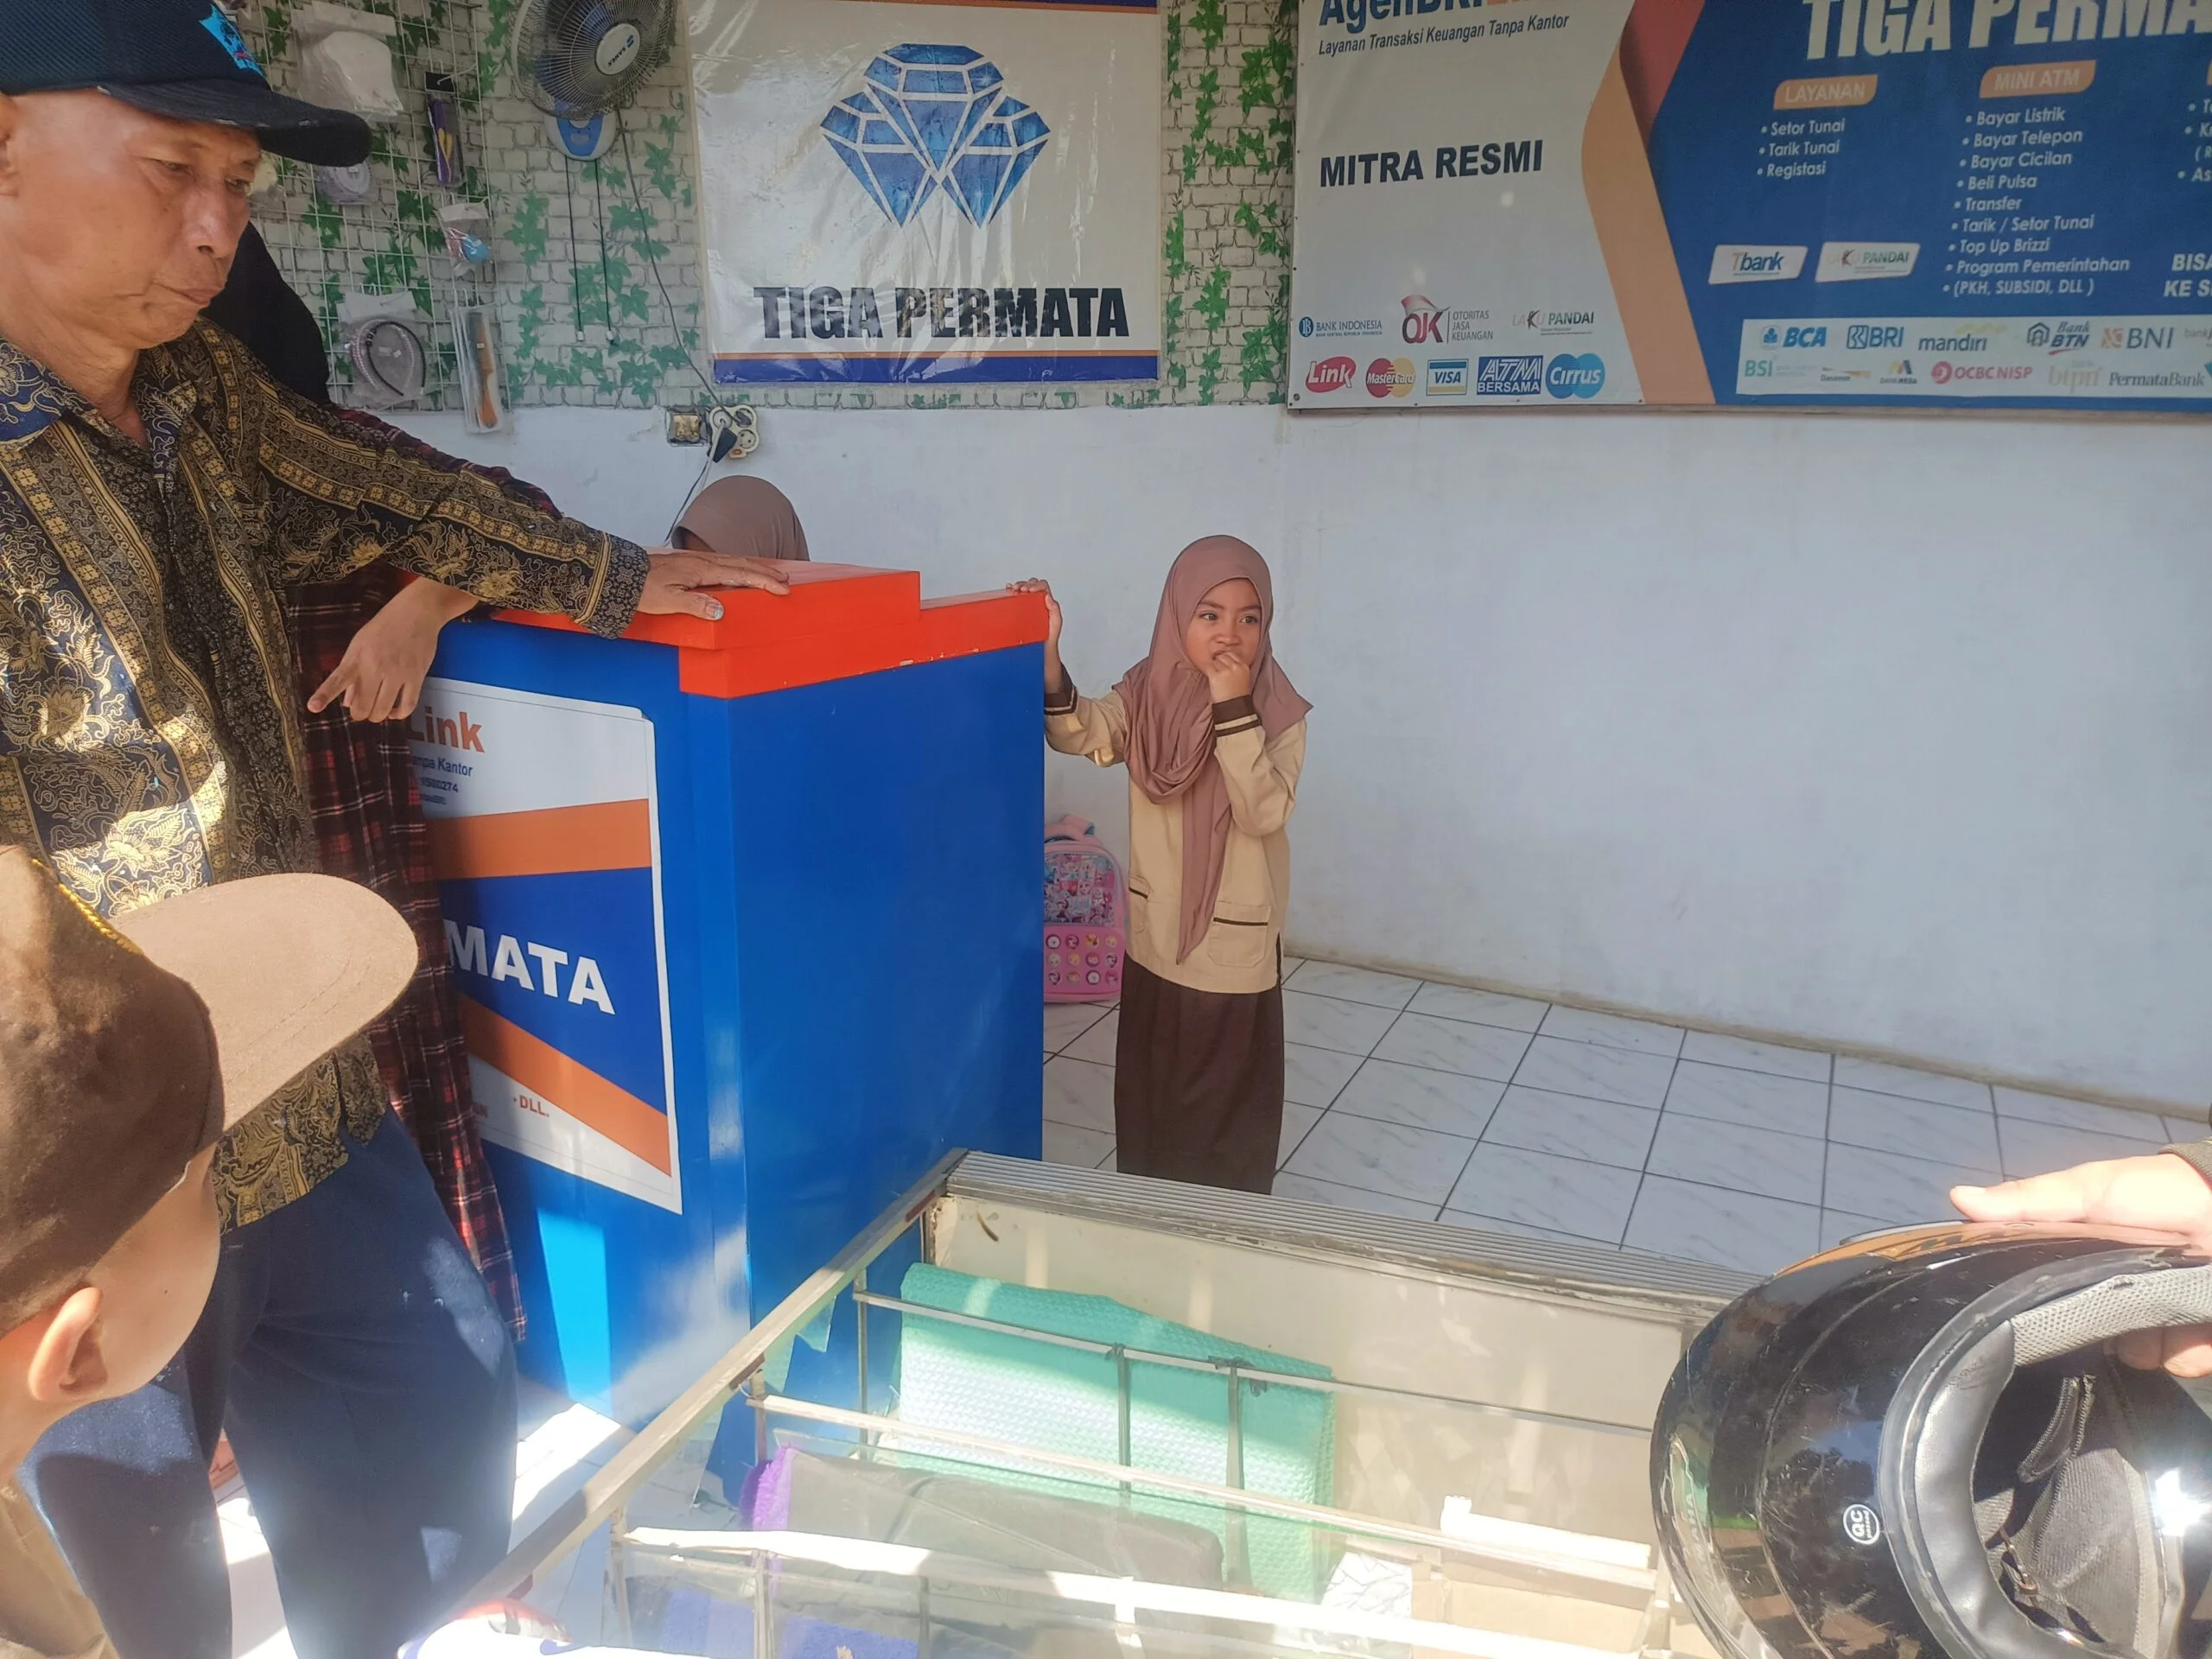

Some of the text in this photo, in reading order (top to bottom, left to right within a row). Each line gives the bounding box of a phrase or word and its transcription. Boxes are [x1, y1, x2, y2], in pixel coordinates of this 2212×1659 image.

[1319, 15, 1569, 57] Layanan Transaksi Keuangan Tanpa Kantor
[1802, 0, 1951, 60] TIGA
[1994, 68, 2080, 90] MINI ATM
[1784, 83, 1866, 103] LAYANAN
[1770, 118, 1845, 136] Setor Tunai
[1976, 108, 2065, 128] Bayar Listrik
[1769, 139, 1840, 156] Tarik Tunai
[1974, 130, 2082, 150] Bayar Telepon
[1320, 139, 1543, 188] MITRA RESMI
[1767, 162, 1827, 179] Registasi
[1971, 153, 2072, 171] Bayar Cicilan
[1968, 175, 2037, 190] Beli Pulsa
[1966, 197, 2023, 212] Transfer
[1963, 219, 1995, 232] Tarik
[2012, 217, 2049, 232] Setor
[2054, 214, 2094, 230] Tunai
[1960, 238, 2050, 256] Top Up Brizzi
[1863, 251, 1910, 264] PANDAI
[1957, 257, 2130, 277] Program Pemerintahan
[1996, 279, 2053, 295] SUBSIDI,
[2164, 280, 2192, 296] KE
[753, 286, 1130, 339] TIGA PERMATA
[1452, 310, 1490, 321] OTORITAS
[1512, 309, 1595, 330] LAKU PANDAI
[1316, 320, 1382, 331] BANK INDONESIA
[1402, 311, 1445, 344] OJK
[1452, 320, 1471, 330] JASA
[2057, 321, 2091, 334] Bank
[1452, 330, 1494, 341] KEUANGAN
[1783, 327, 1827, 347] BCA
[1869, 327, 1904, 347] BRI
[1918, 334, 1987, 351] mandiri
[2050, 334, 2090, 347] BTN
[2126, 327, 2176, 349] BNI
[1307, 361, 1352, 388] Link
[1478, 359, 1541, 382] ATM
[1549, 366, 1601, 386] Cirrus
[1744, 359, 1773, 378] BSI
[1955, 366, 2033, 380] OCBC NISP
[1367, 372, 1414, 386] MasterCard
[1434, 371, 1461, 385] VISA
[1477, 382, 1540, 392] BERSAMA
[2108, 372, 2205, 388] PermataBank
[437, 757, 474, 777] Kantor
[1850, 1510, 1865, 1537] QC
